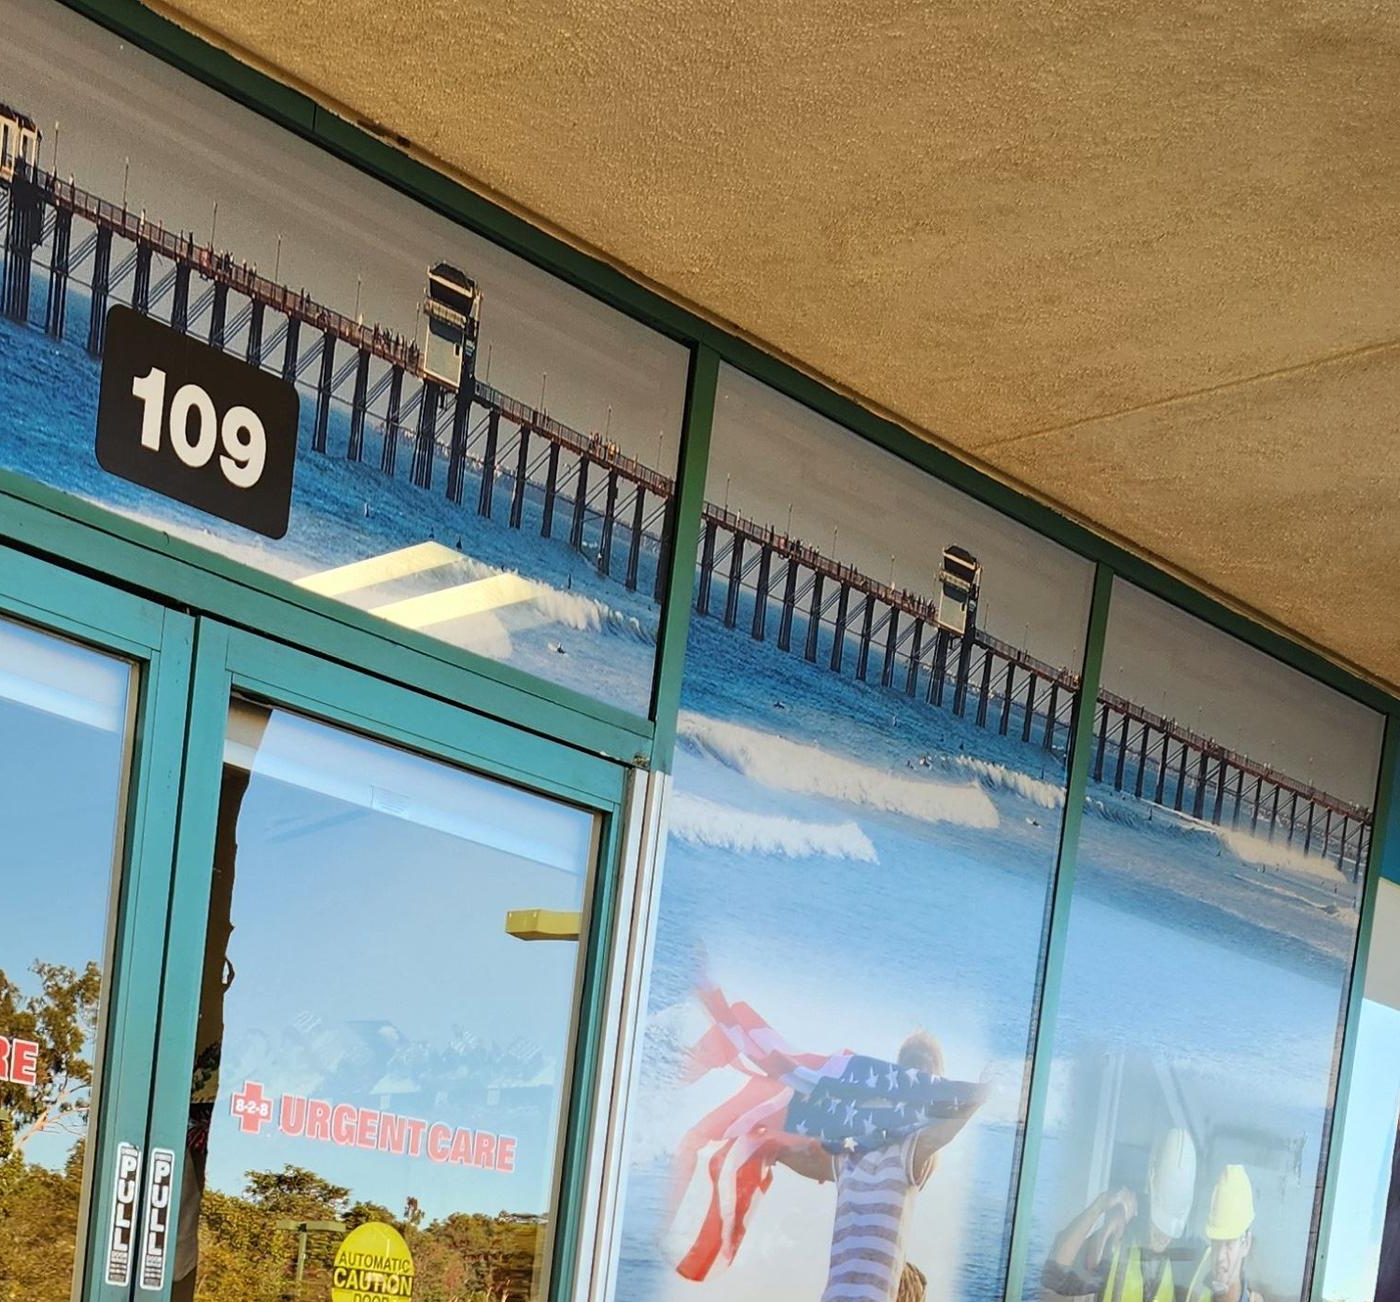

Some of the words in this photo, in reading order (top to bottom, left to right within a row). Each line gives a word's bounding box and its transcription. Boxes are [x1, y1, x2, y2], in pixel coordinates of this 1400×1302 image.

[132, 366, 267, 488] 109
[235, 1099, 269, 1117] 8-2-8
[281, 1094, 427, 1157] URGENT
[428, 1121, 517, 1173] CARE
[113, 1155, 137, 1251] PULL
[147, 1160, 171, 1256] PULL
[334, 1268, 412, 1296] CAUTION
[339, 1251, 410, 1273] AUTOMATIC
